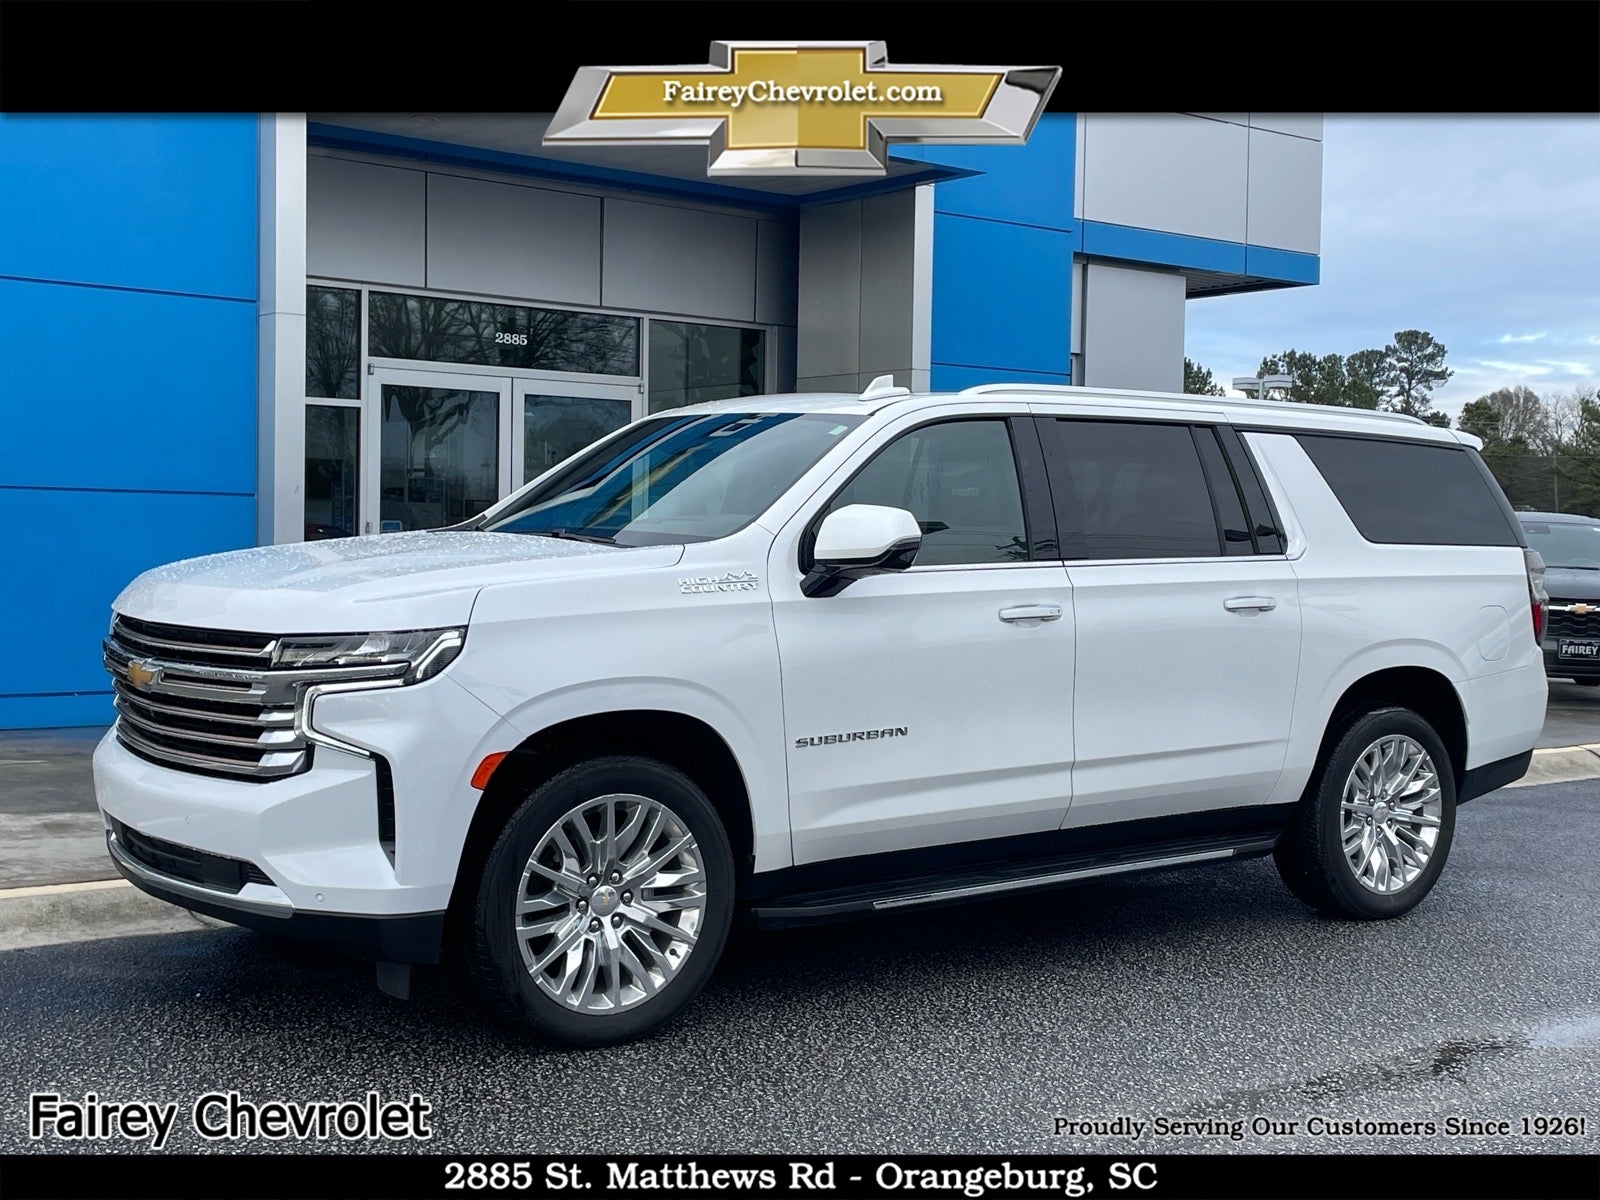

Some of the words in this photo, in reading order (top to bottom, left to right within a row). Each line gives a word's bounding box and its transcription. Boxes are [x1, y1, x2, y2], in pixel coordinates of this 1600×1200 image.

[495, 332, 528, 346] 2885
[677, 576, 720, 586] HIGH
[679, 582, 759, 595] COUNTRY
[1562, 645, 1599, 655] FAIREY
[795, 726, 909, 748] SUBURBAN
